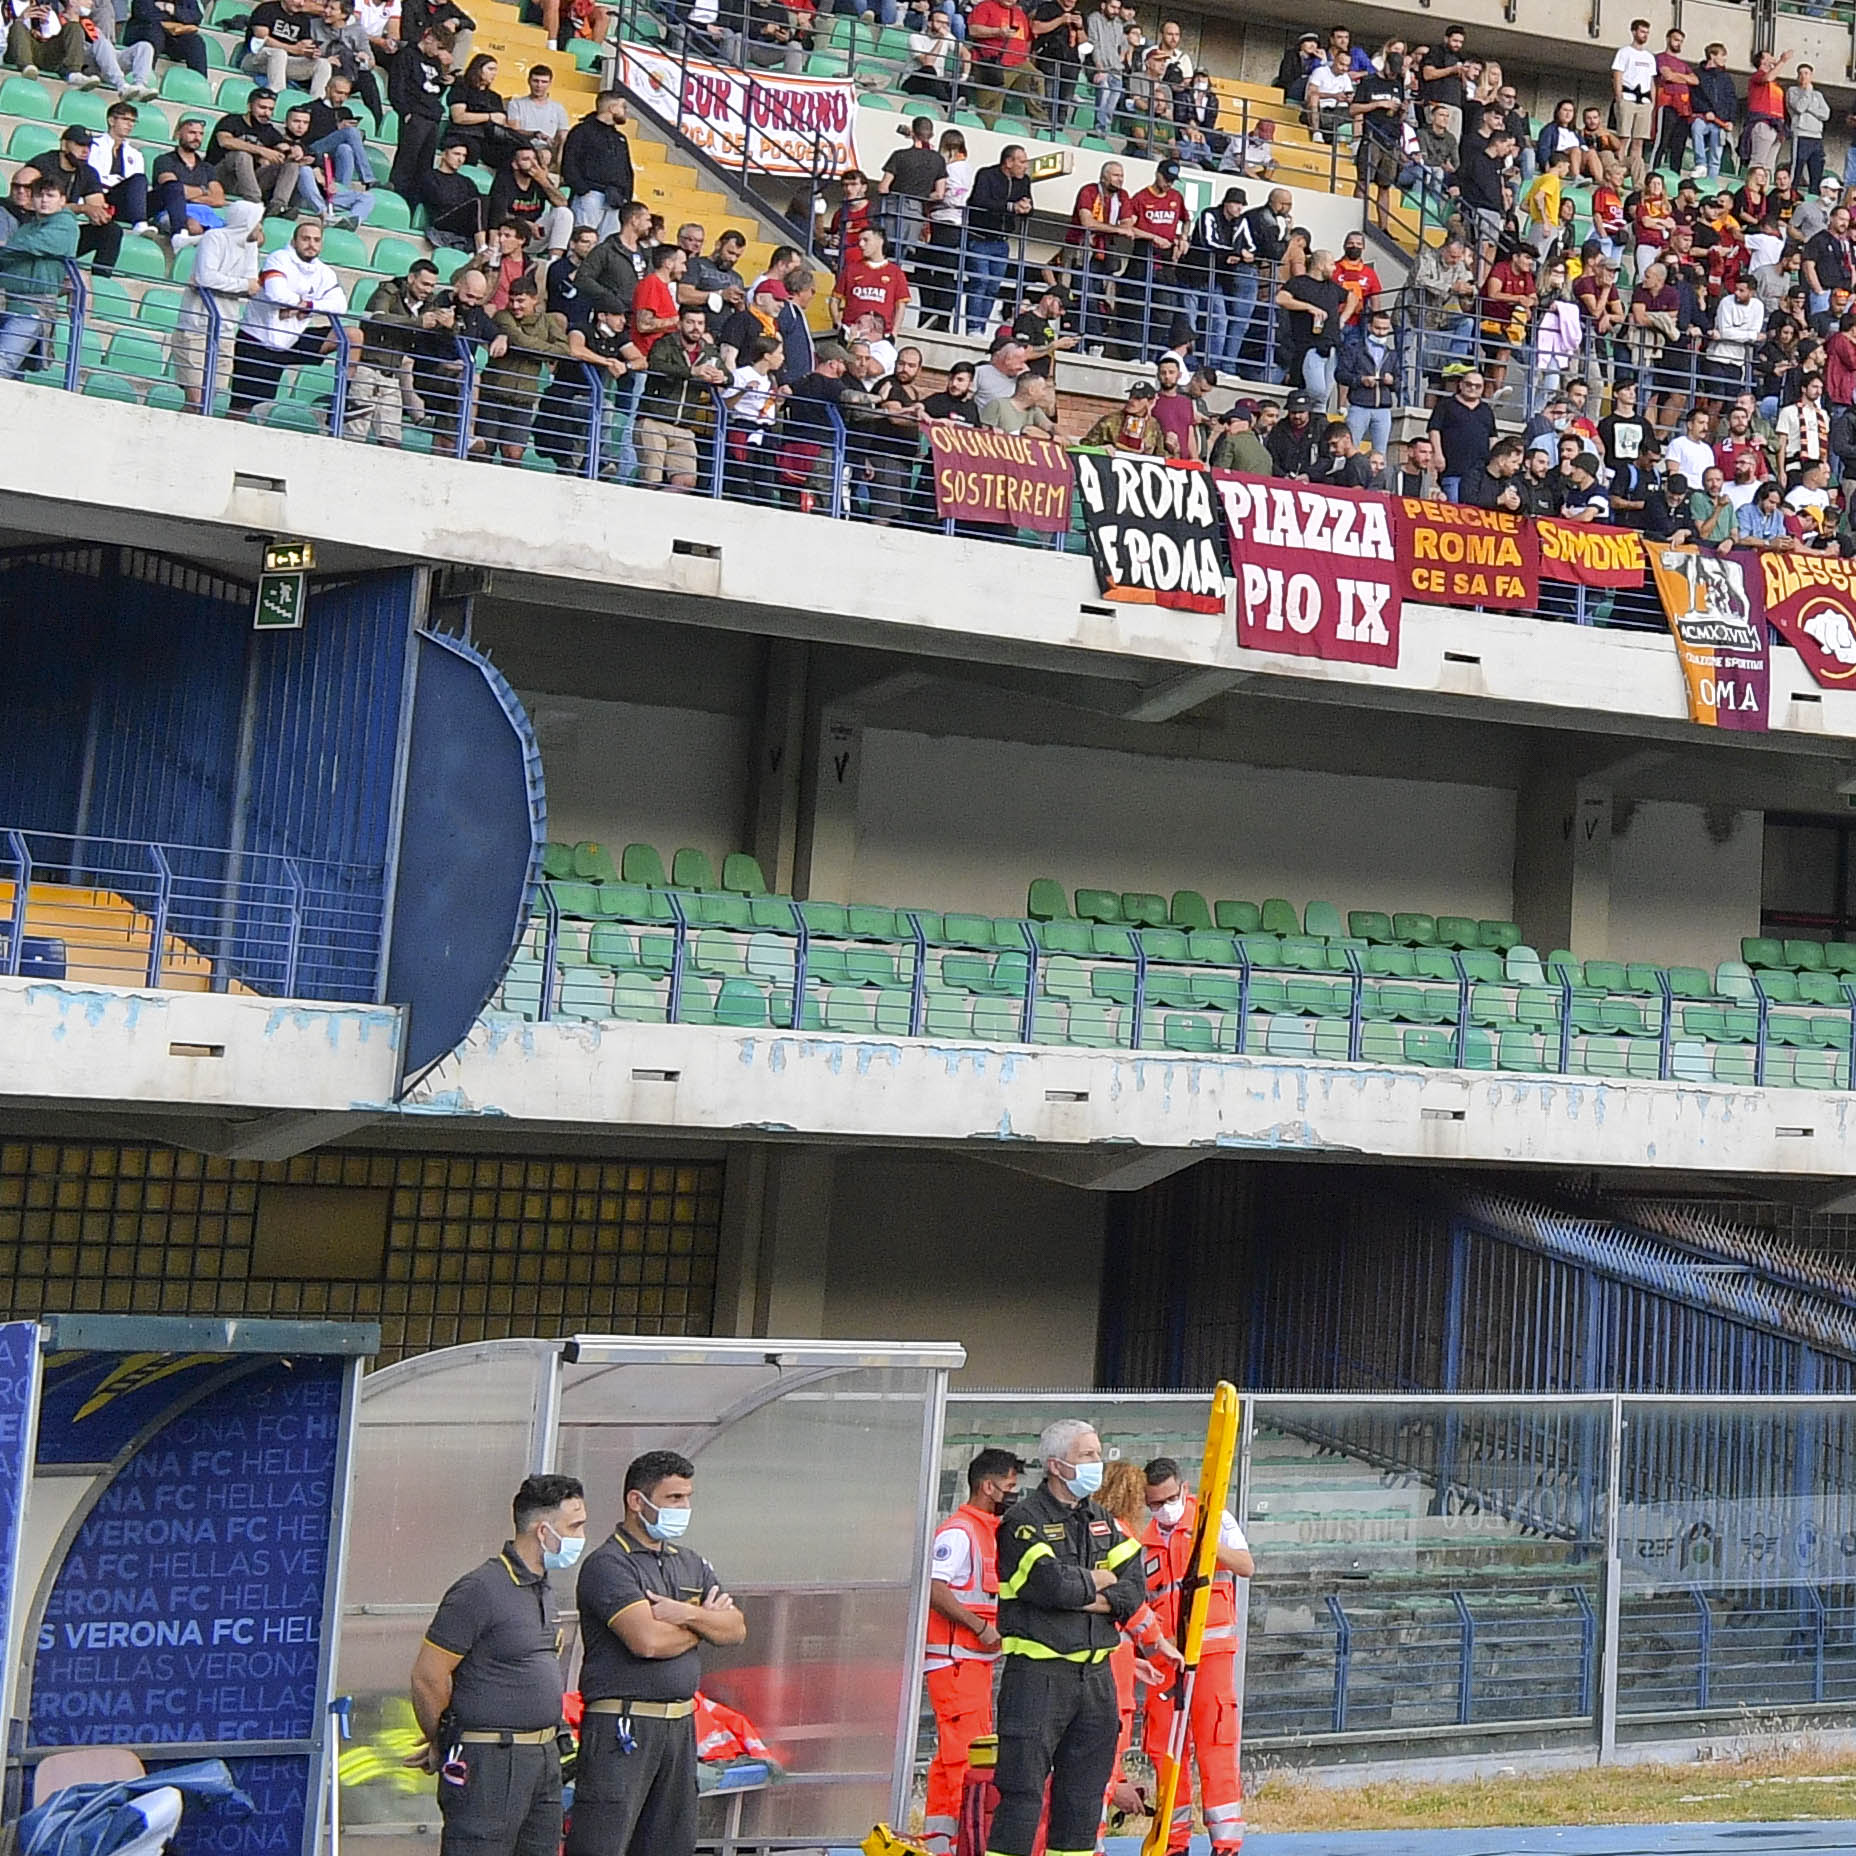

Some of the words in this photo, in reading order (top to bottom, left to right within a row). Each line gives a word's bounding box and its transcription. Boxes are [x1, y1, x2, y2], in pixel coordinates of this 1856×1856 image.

[930, 425, 1037, 466] OVUNQUE
[1038, 440, 1067, 470] TI
[940, 470, 1066, 518] SOSTERREM
[1112, 457, 1214, 528] ROTA
[1215, 479, 1396, 562] PIAZZA
[1402, 498, 1521, 534] PERCHE'
[1413, 528, 1523, 567] ROMA
[1537, 520, 1645, 570] SIMONE
[1124, 528, 1226, 599] ROMA
[1411, 568, 1445, 593] CE
[1453, 571, 1489, 596] SA
[1495, 575, 1526, 598] FA
[1241, 563, 1321, 634] PIO
[1336, 578, 1390, 645] IX
[1699, 678, 1759, 712] OMA
[191, 1450, 232, 1476] FC
[155, 1485, 196, 1511] FC
[206, 1481, 328, 1509] HELLAS
[82, 1518, 217, 1545] VERONA
[227, 1516, 268, 1543] FC
[100, 1554, 139, 1581] FC
[150, 1550, 270, 1579] HELLAS
[170, 1585, 210, 1612] FC
[64, 1620, 202, 1650] VERONA
[212, 1618, 254, 1644] FC
[51, 1654, 174, 1683] HELLAS
[183, 1652, 318, 1681] VERONA
[144, 1688, 187, 1715] FC
